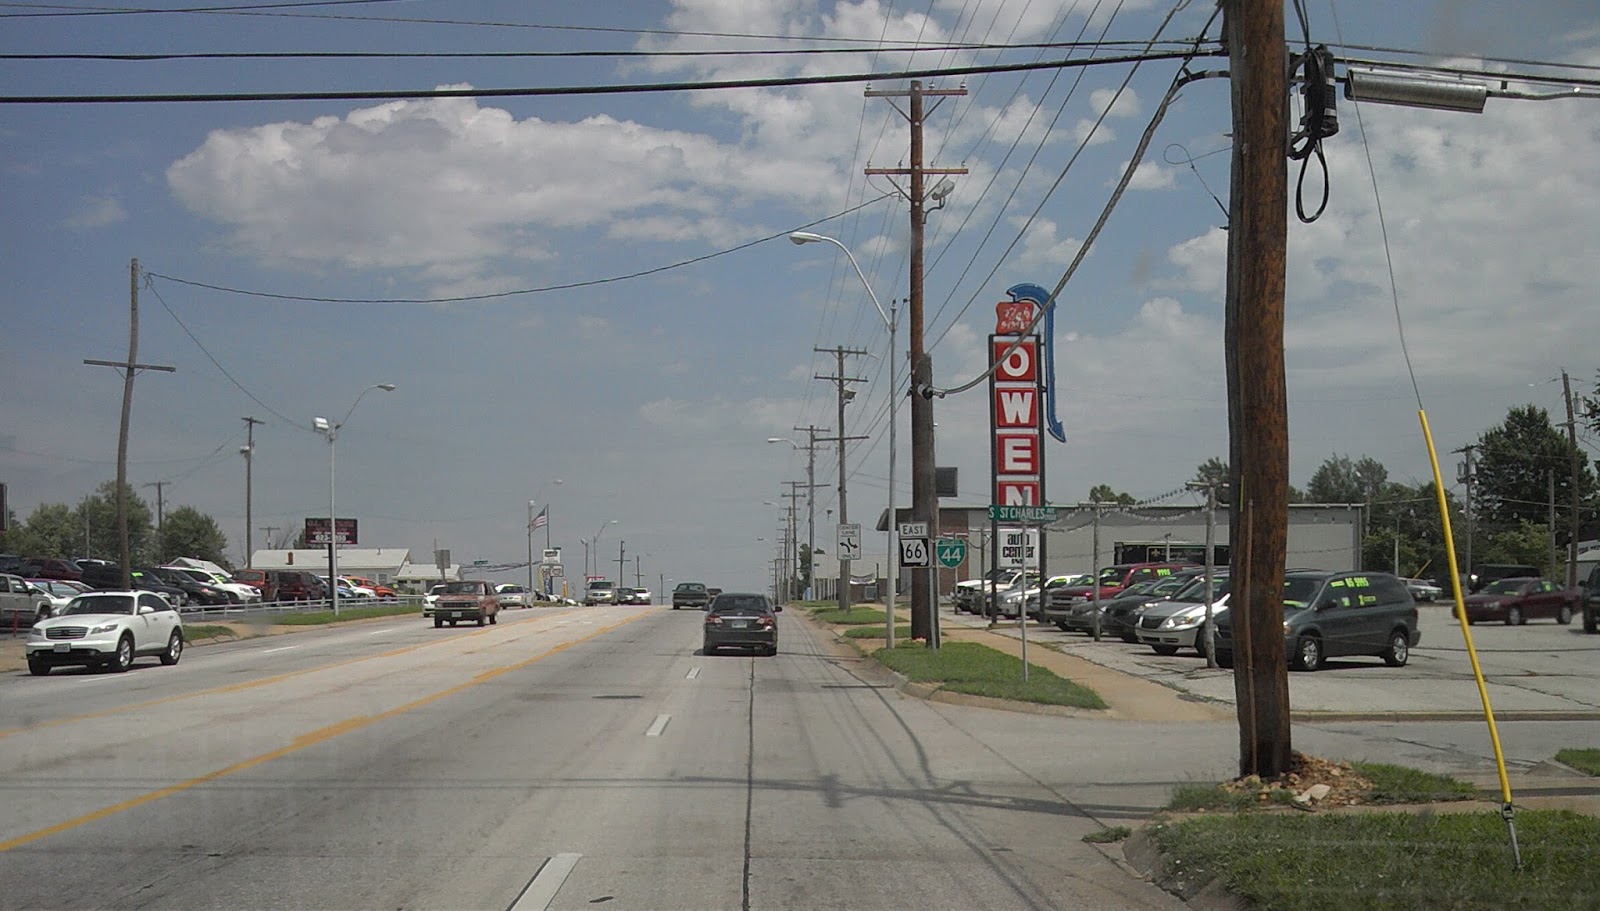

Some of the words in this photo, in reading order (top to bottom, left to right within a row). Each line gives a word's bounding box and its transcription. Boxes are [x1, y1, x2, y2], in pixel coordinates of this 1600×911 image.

[1001, 346, 1034, 506] OWEN
[989, 506, 995, 519] S
[902, 526, 924, 535] EAST
[906, 544, 922, 559] 66
[941, 547, 962, 562] 44
